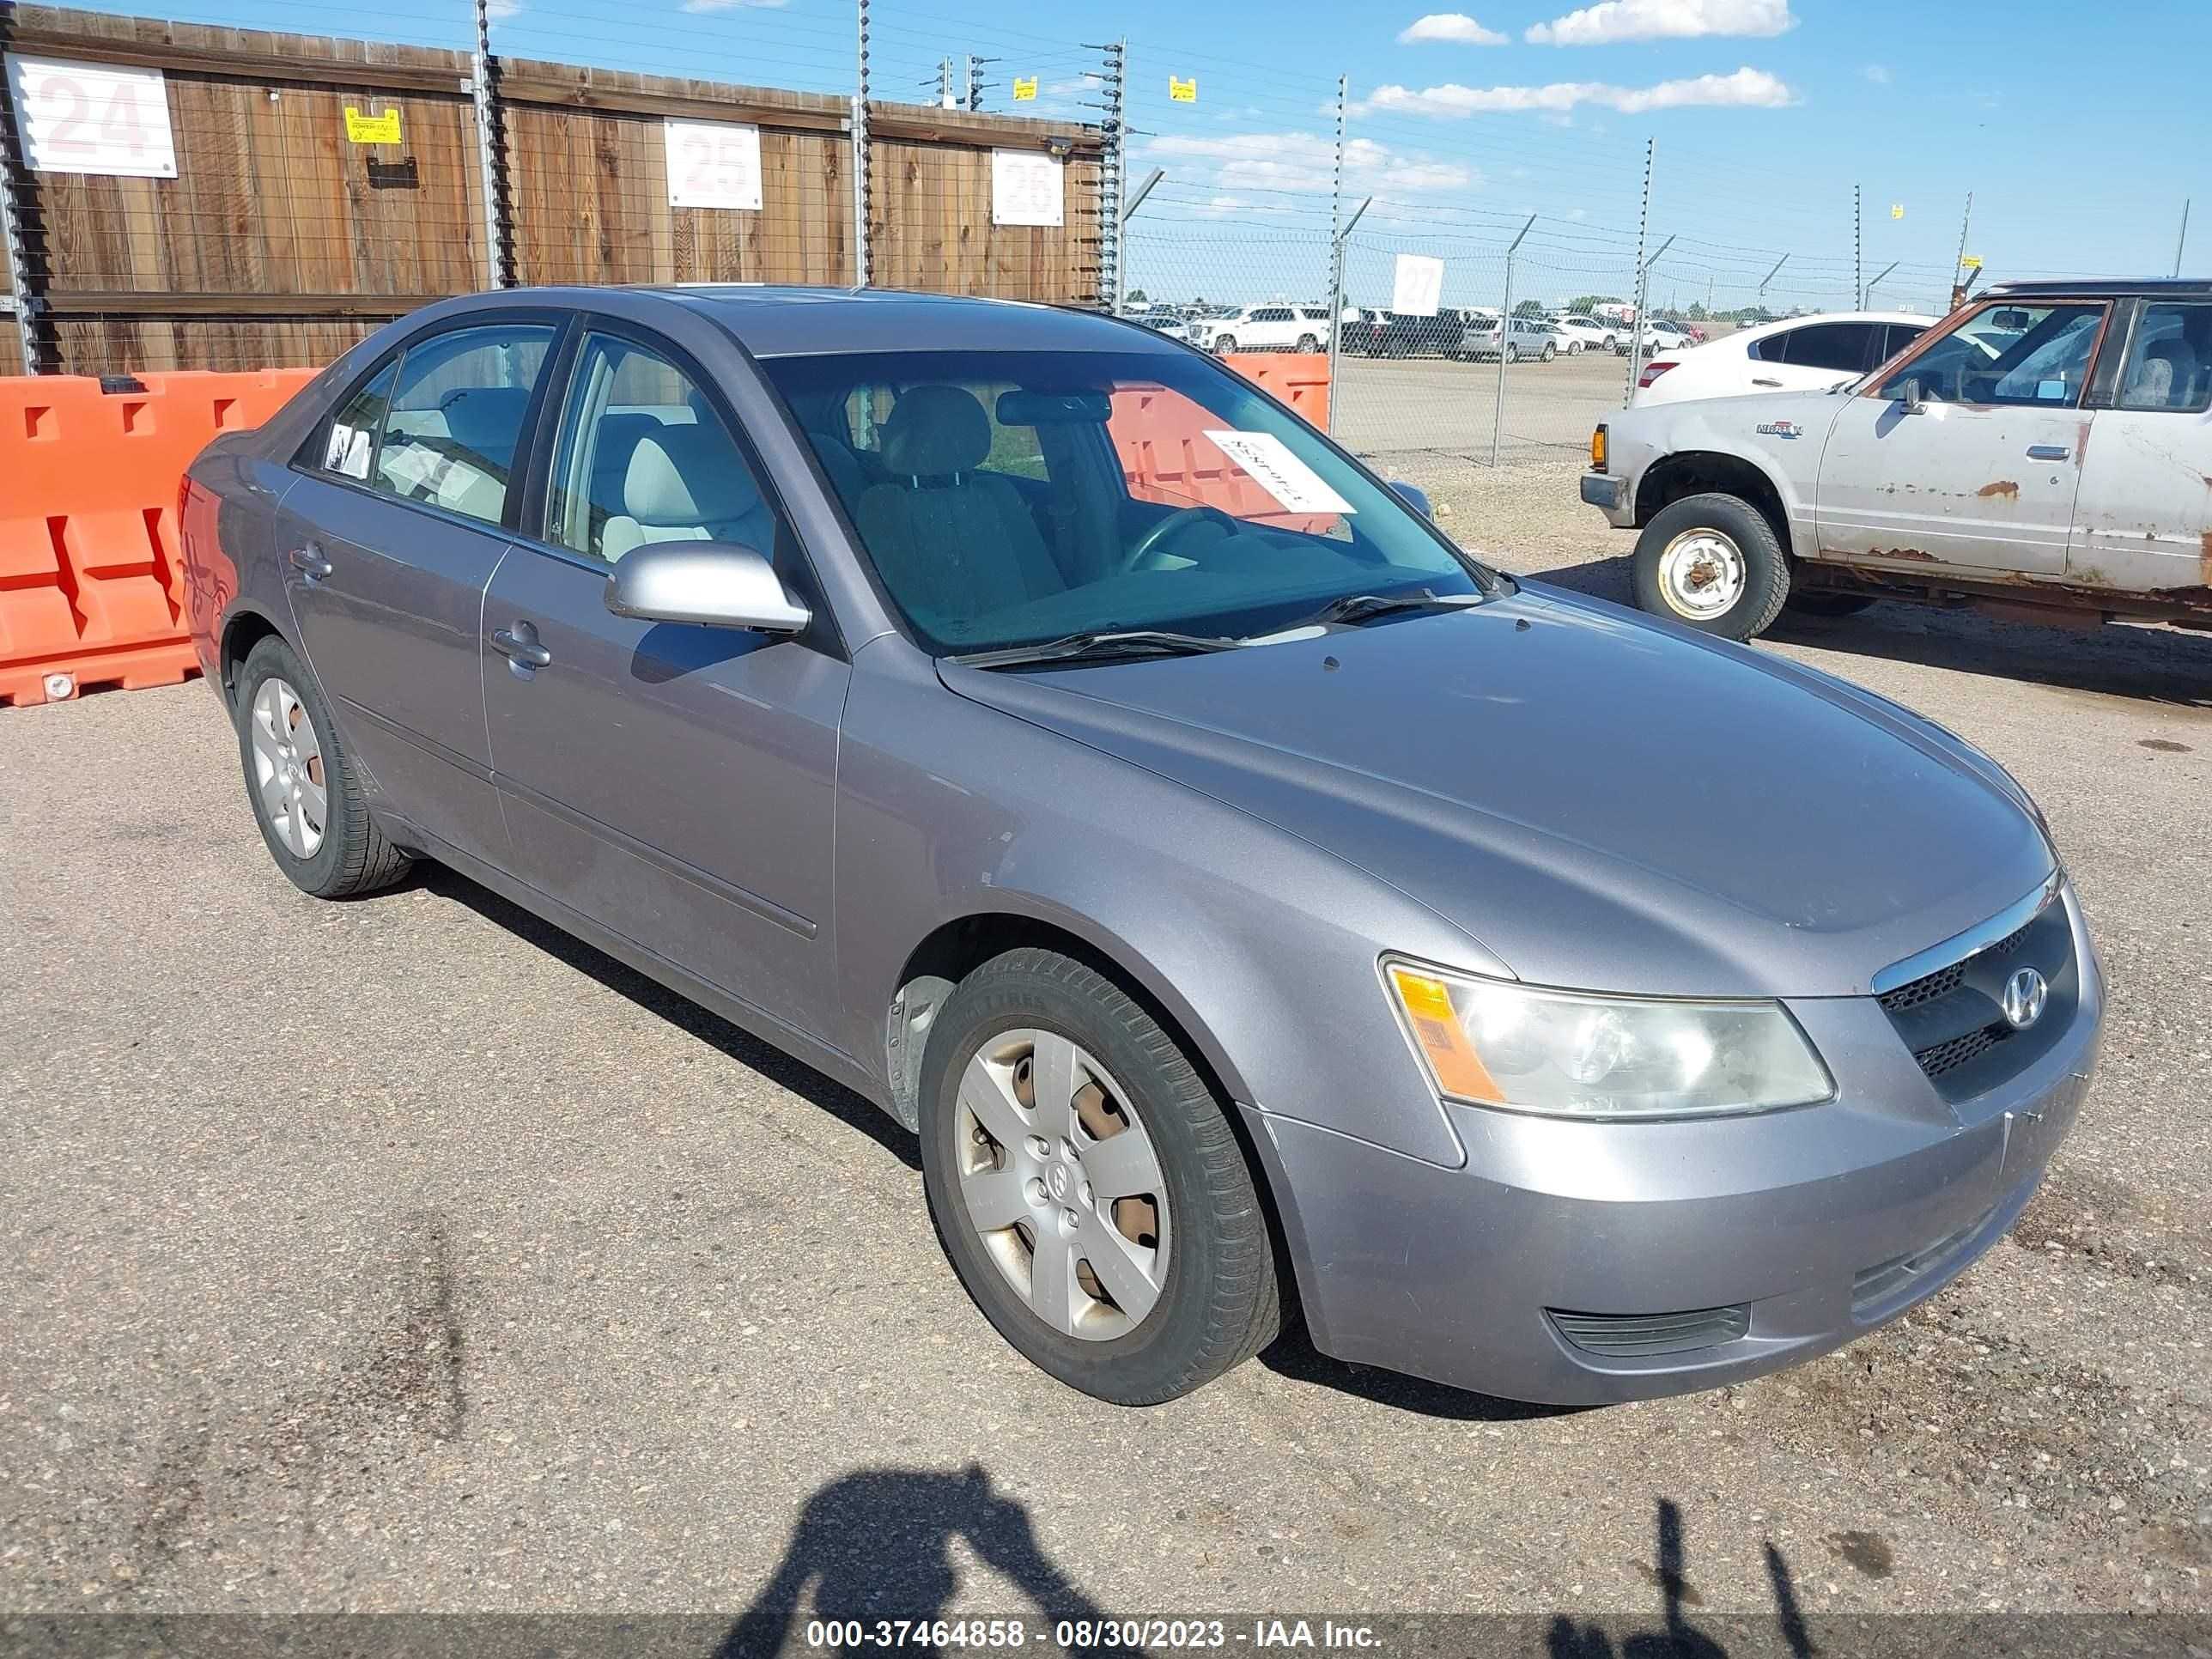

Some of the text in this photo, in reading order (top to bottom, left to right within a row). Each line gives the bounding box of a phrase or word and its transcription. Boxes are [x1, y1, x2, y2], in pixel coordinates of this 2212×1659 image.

[40, 76, 149, 157] 24
[682, 134, 746, 193] 25
[1005, 161, 1052, 213] 26
[1401, 266, 1434, 305] 27
